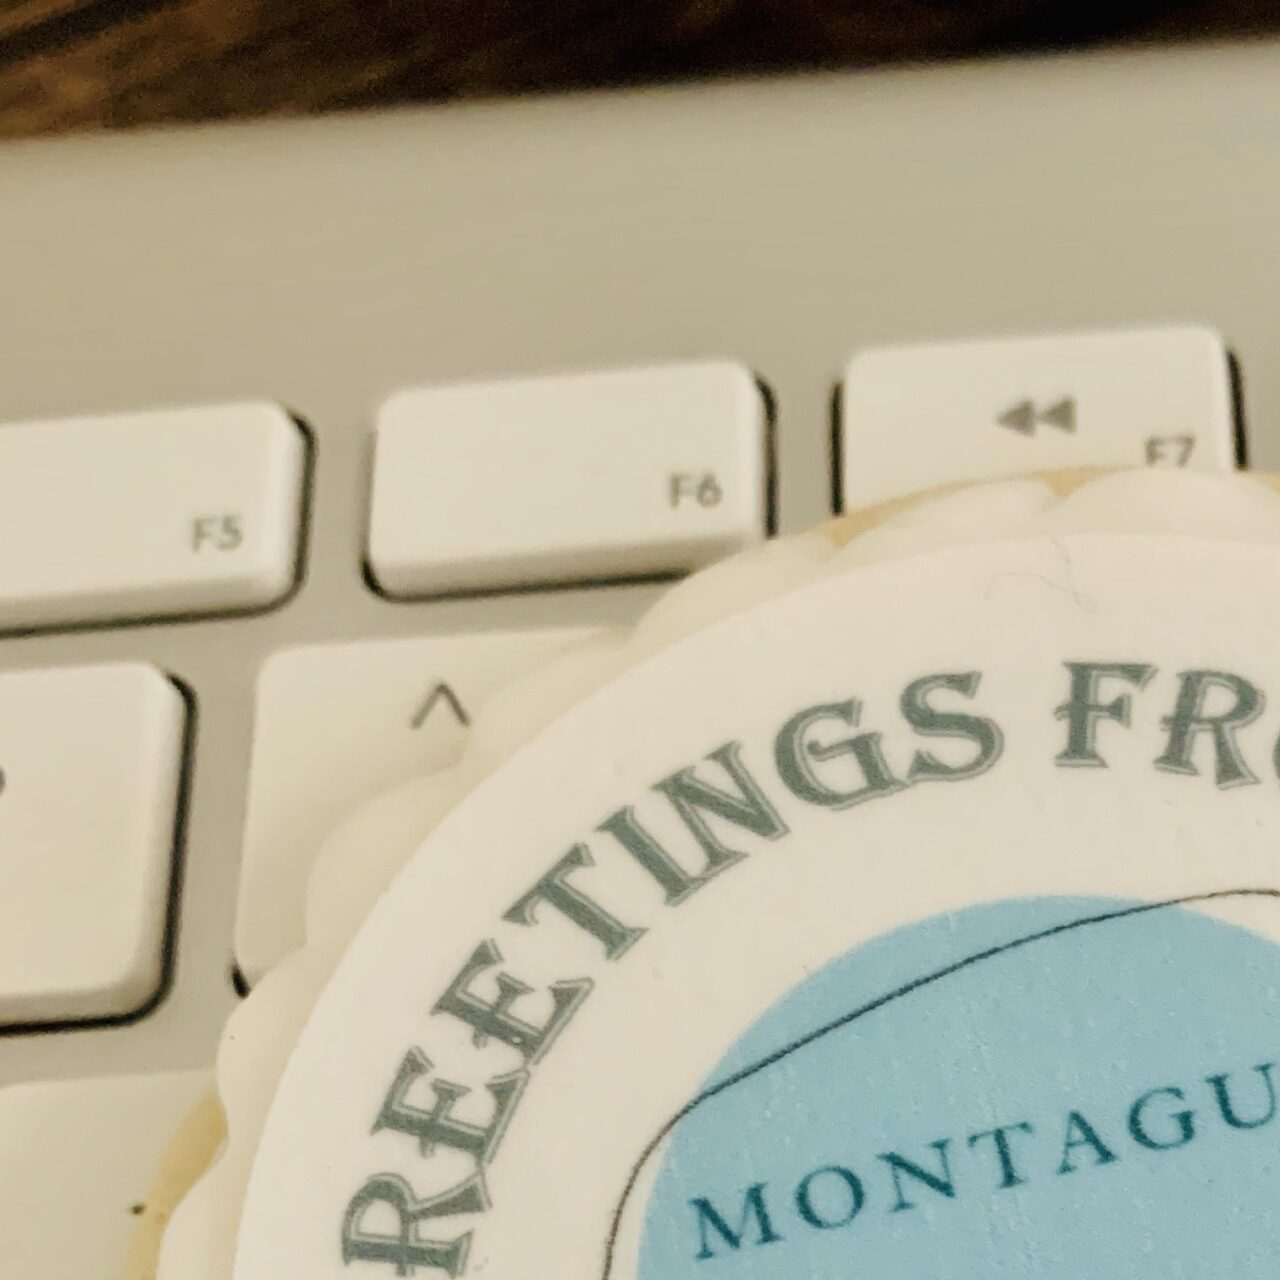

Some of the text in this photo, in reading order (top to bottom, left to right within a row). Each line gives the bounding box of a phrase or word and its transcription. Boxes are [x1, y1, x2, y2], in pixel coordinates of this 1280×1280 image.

[1143, 434, 1197, 468] F7
[667, 471, 723, 510] F6
[190, 514, 244, 553] F5
